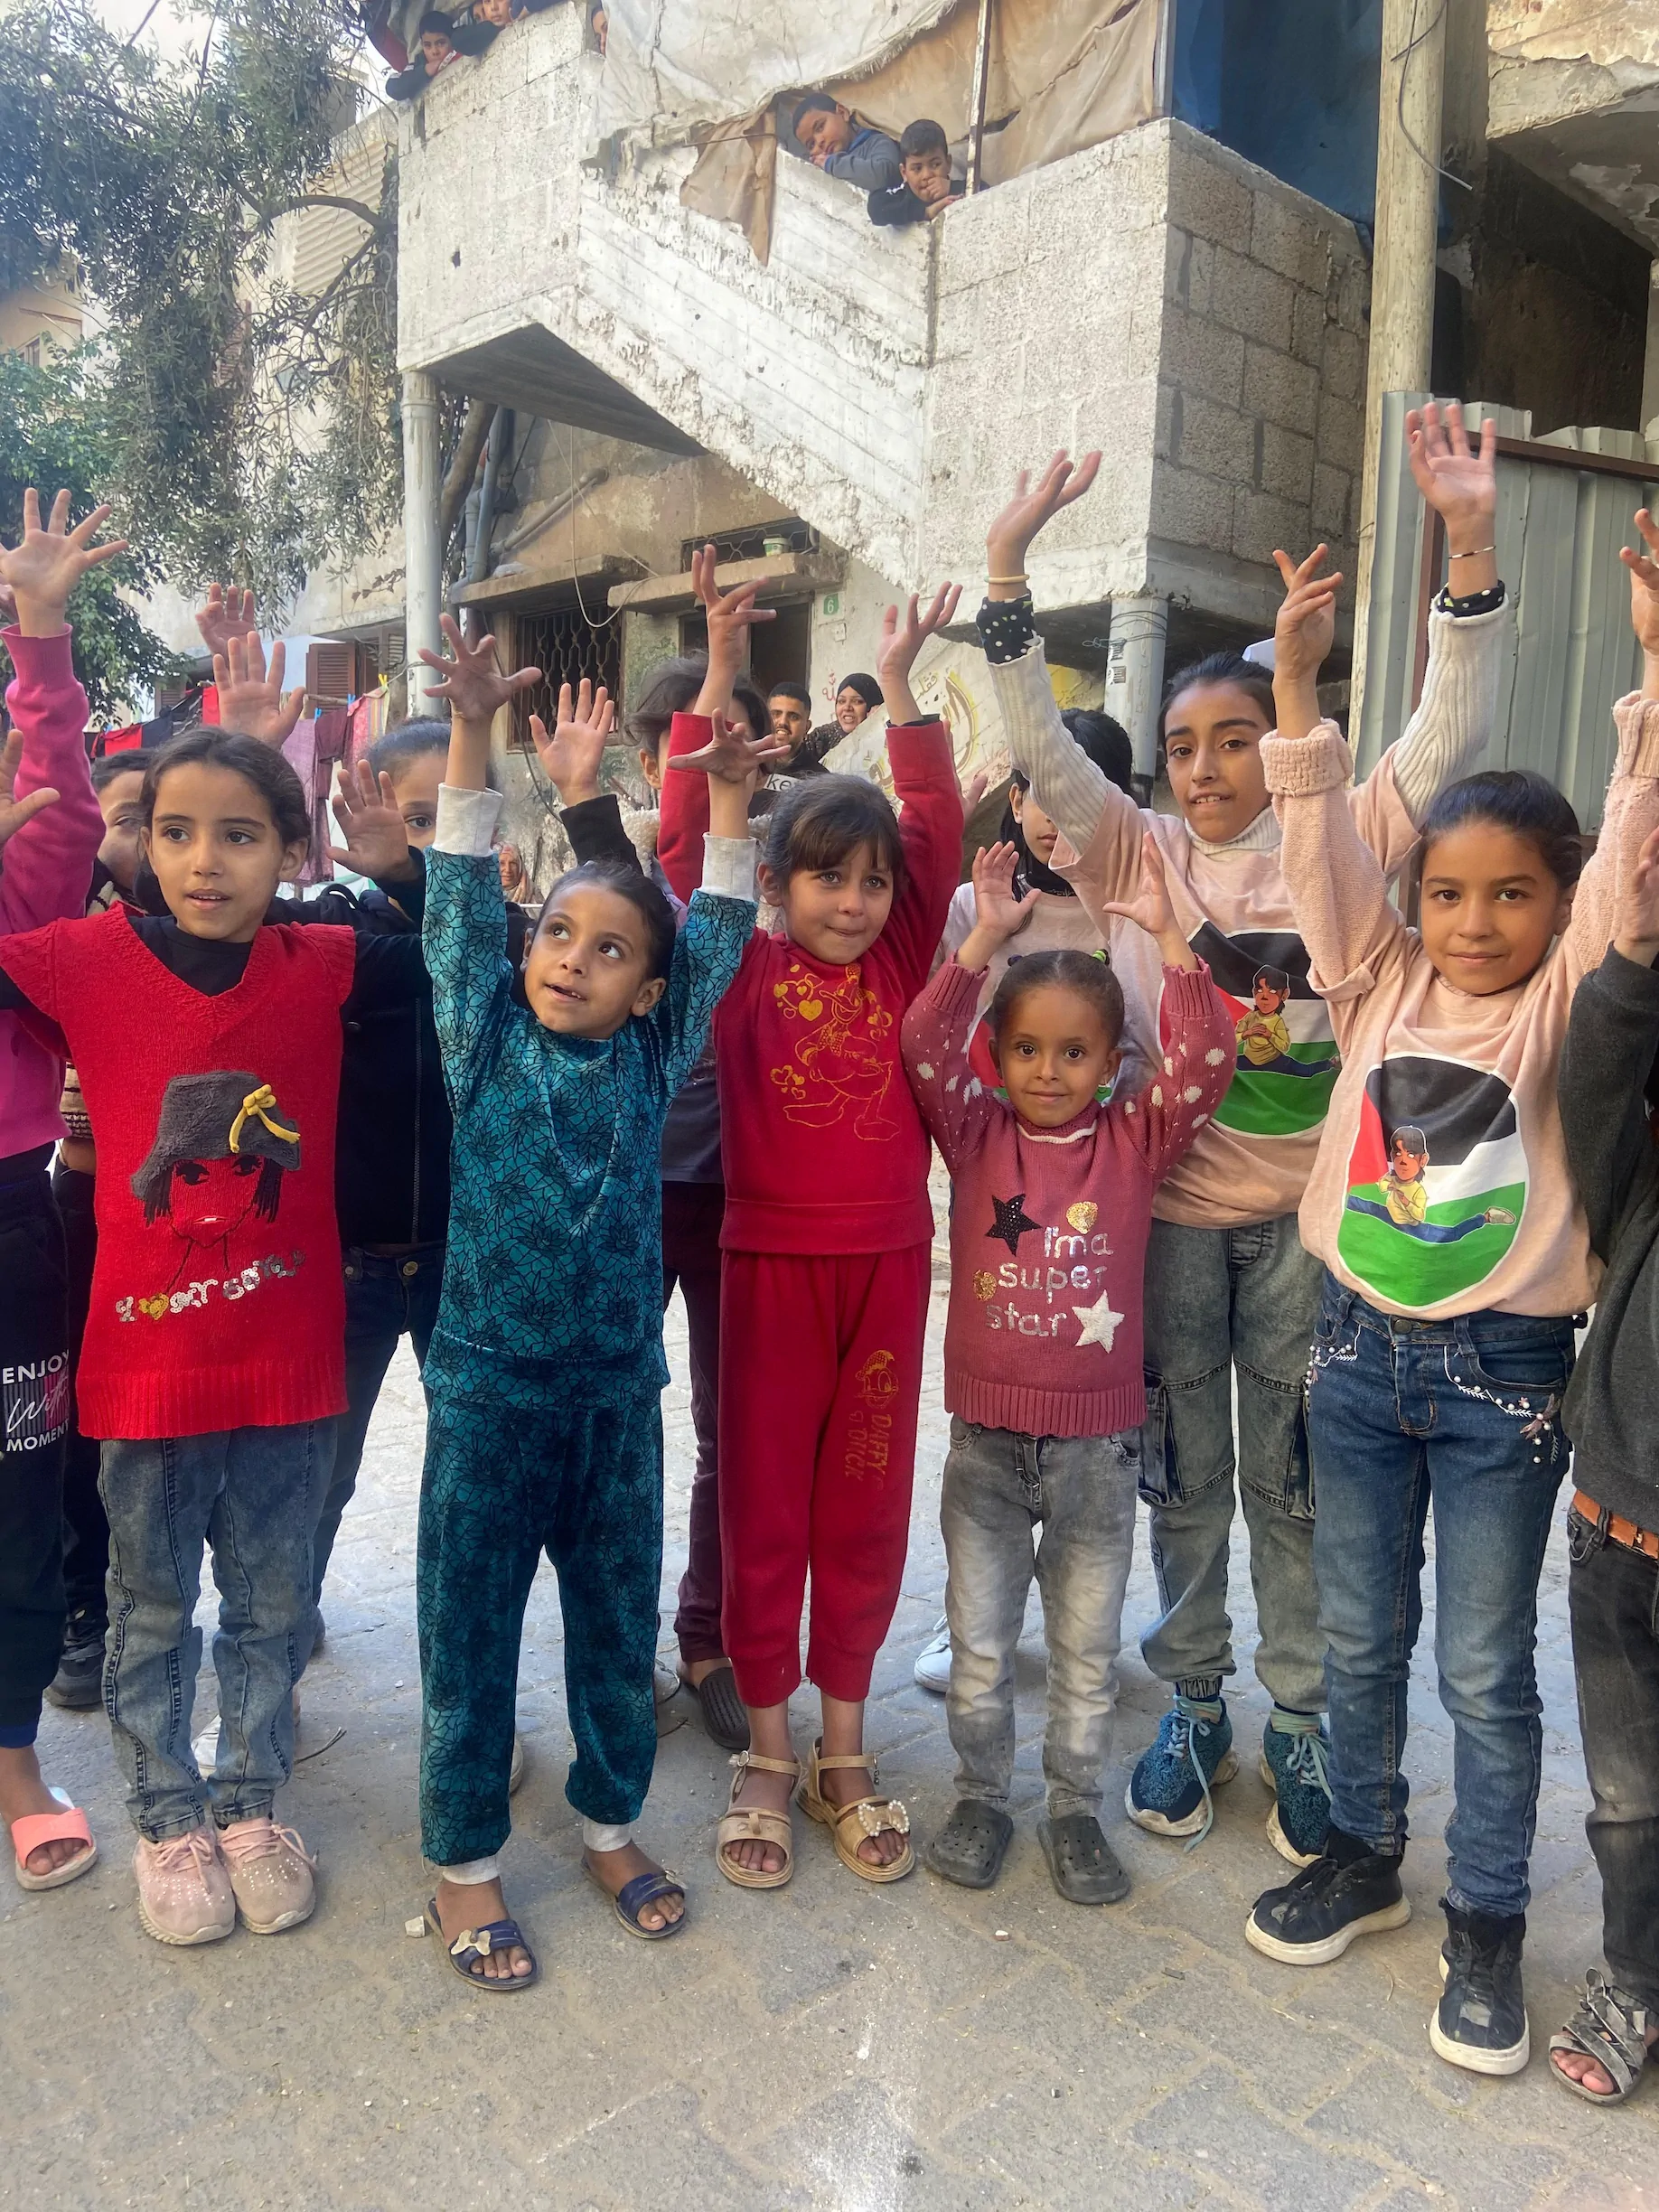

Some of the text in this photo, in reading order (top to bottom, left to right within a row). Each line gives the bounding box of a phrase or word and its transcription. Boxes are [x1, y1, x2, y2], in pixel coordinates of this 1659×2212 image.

[827, 599, 834, 614] 6
[986, 1302, 1067, 1336] star
[3, 1348, 70, 1384] ENJOY
[867, 1413, 892, 1476] DAFFY
